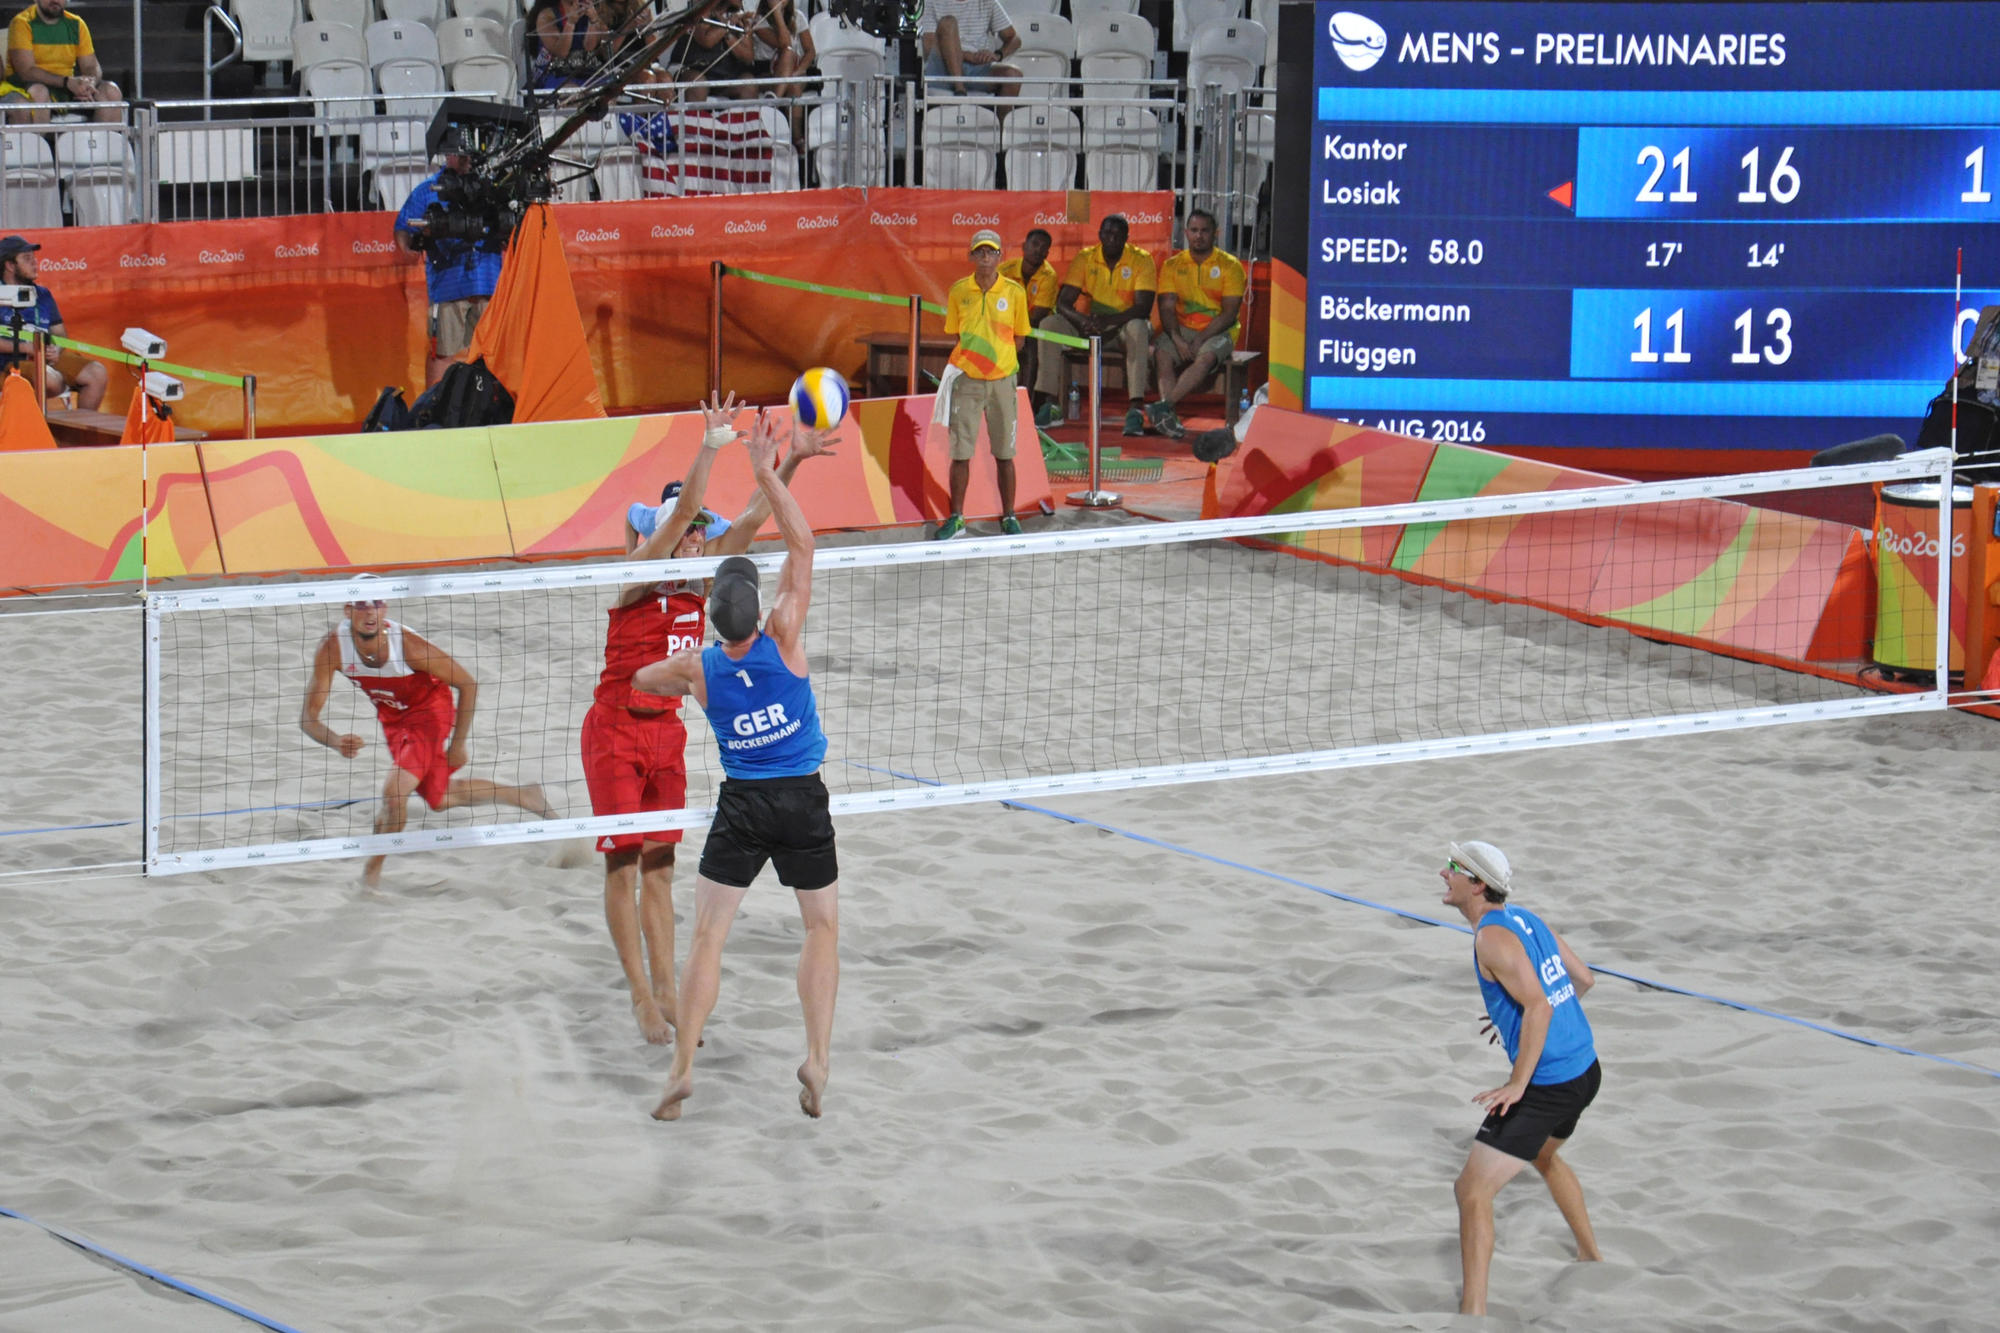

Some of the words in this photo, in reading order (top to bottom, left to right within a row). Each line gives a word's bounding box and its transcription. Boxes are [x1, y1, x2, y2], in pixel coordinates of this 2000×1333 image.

[1398, 31, 1501, 65] MEN'S
[1534, 33, 1787, 66] PRELIMINARIES
[1324, 134, 1408, 162] Kantor
[1635, 145, 1699, 204] 21
[1738, 146, 1802, 204] 16
[1960, 146, 1992, 203] 1
[1322, 179, 1401, 206] Losiak
[797, 215, 839, 230] Rio2016
[870, 211, 918, 226] Rio2016
[952, 212, 1000, 226] Rio2016
[1033, 211, 1068, 225] Rio20
[651, 224, 695, 239] Rio2016
[725, 219, 767, 234] Rio2016
[576, 228, 620, 243] Rio2016
[275, 242, 320, 258] Rio2016
[353, 240, 396, 255] Rio2016
[1320, 237, 1408, 265] SPEED:
[1427, 239, 1484, 265] 58.0
[39, 256, 88, 272] Rio2016
[119, 252, 167, 268] Rio2016
[199, 249, 245, 264] Rio2016
[1319, 294, 1471, 323] Böckermann
[1630, 307, 1692, 364] 11
[1731, 307, 1794, 365] 13
[1318, 339, 1417, 373] Flüggen
[1431, 419, 1487, 443] 2016
[1877, 527, 1966, 558] Rio206
[657, 596, 668, 614] 1
[735, 669, 754, 688] 1
[733, 703, 789, 737] GER
